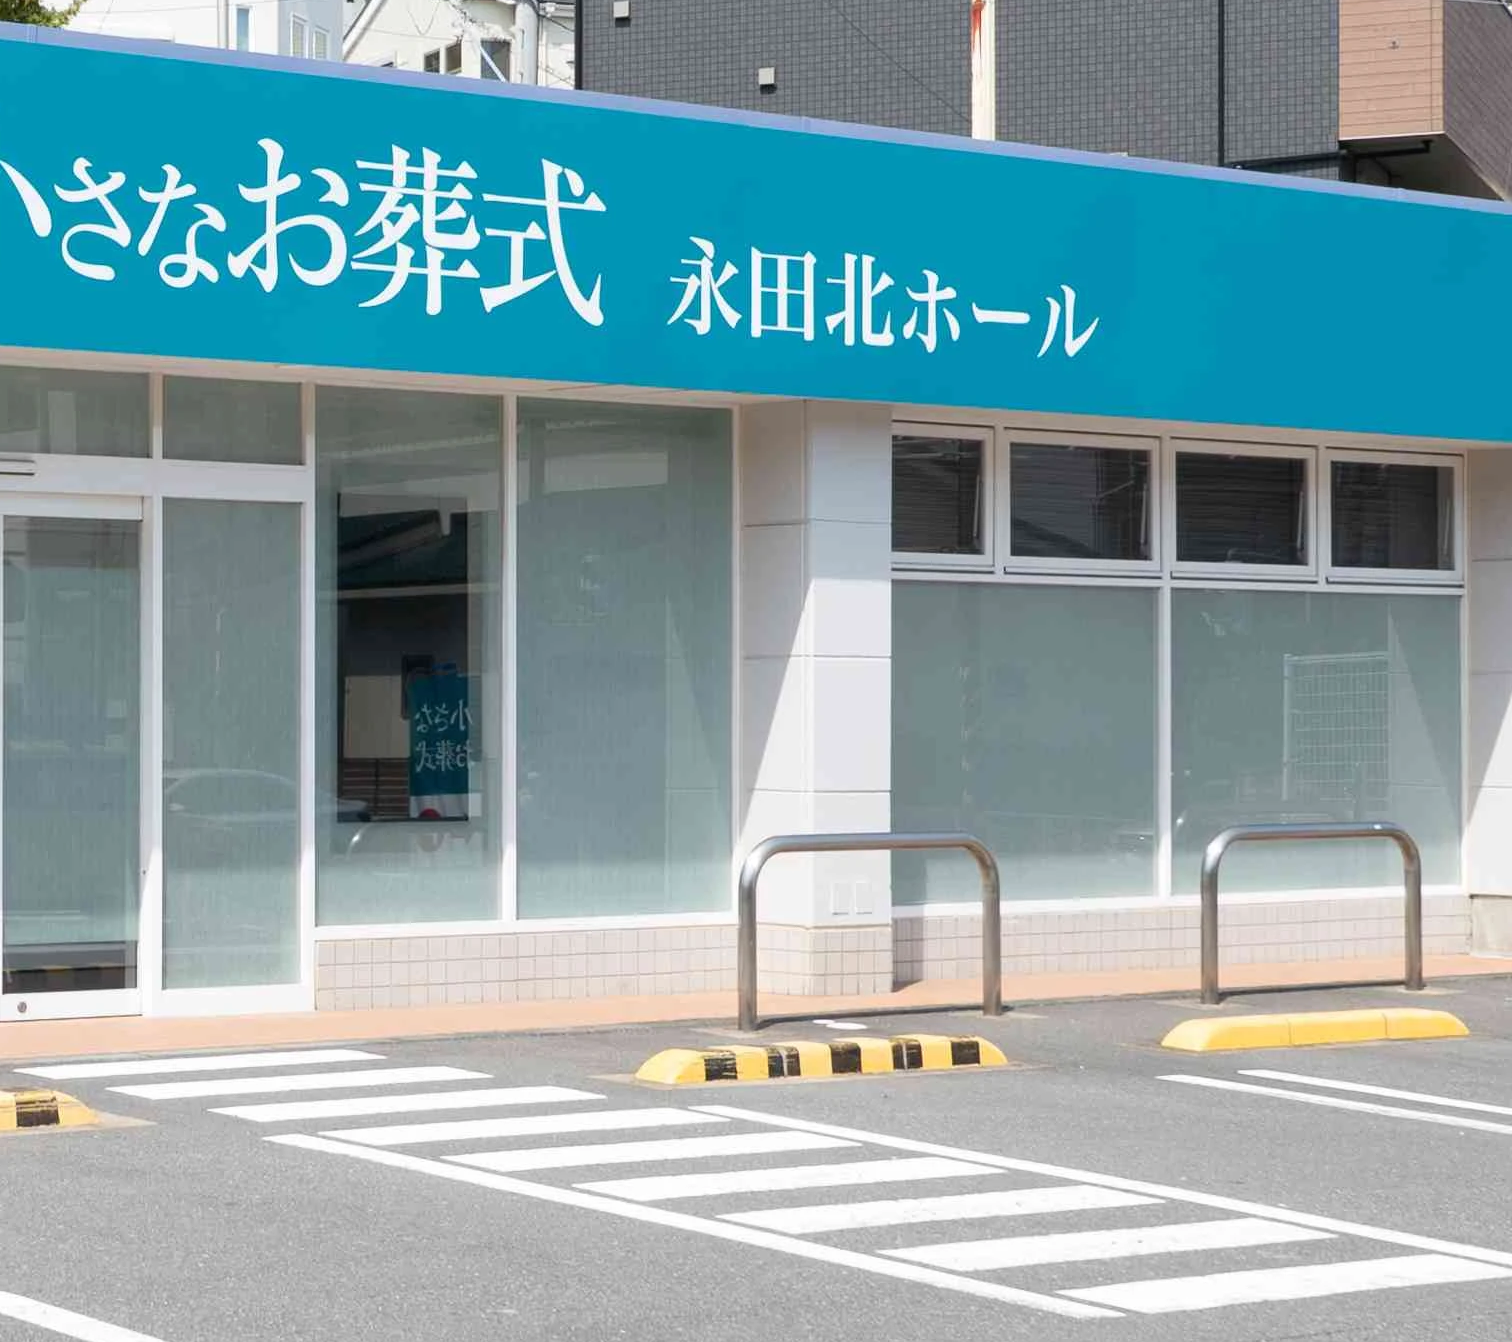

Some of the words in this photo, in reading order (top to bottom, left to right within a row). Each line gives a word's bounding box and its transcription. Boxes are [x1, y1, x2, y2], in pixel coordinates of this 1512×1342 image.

[666, 235, 1099, 358] 永田北ホール
